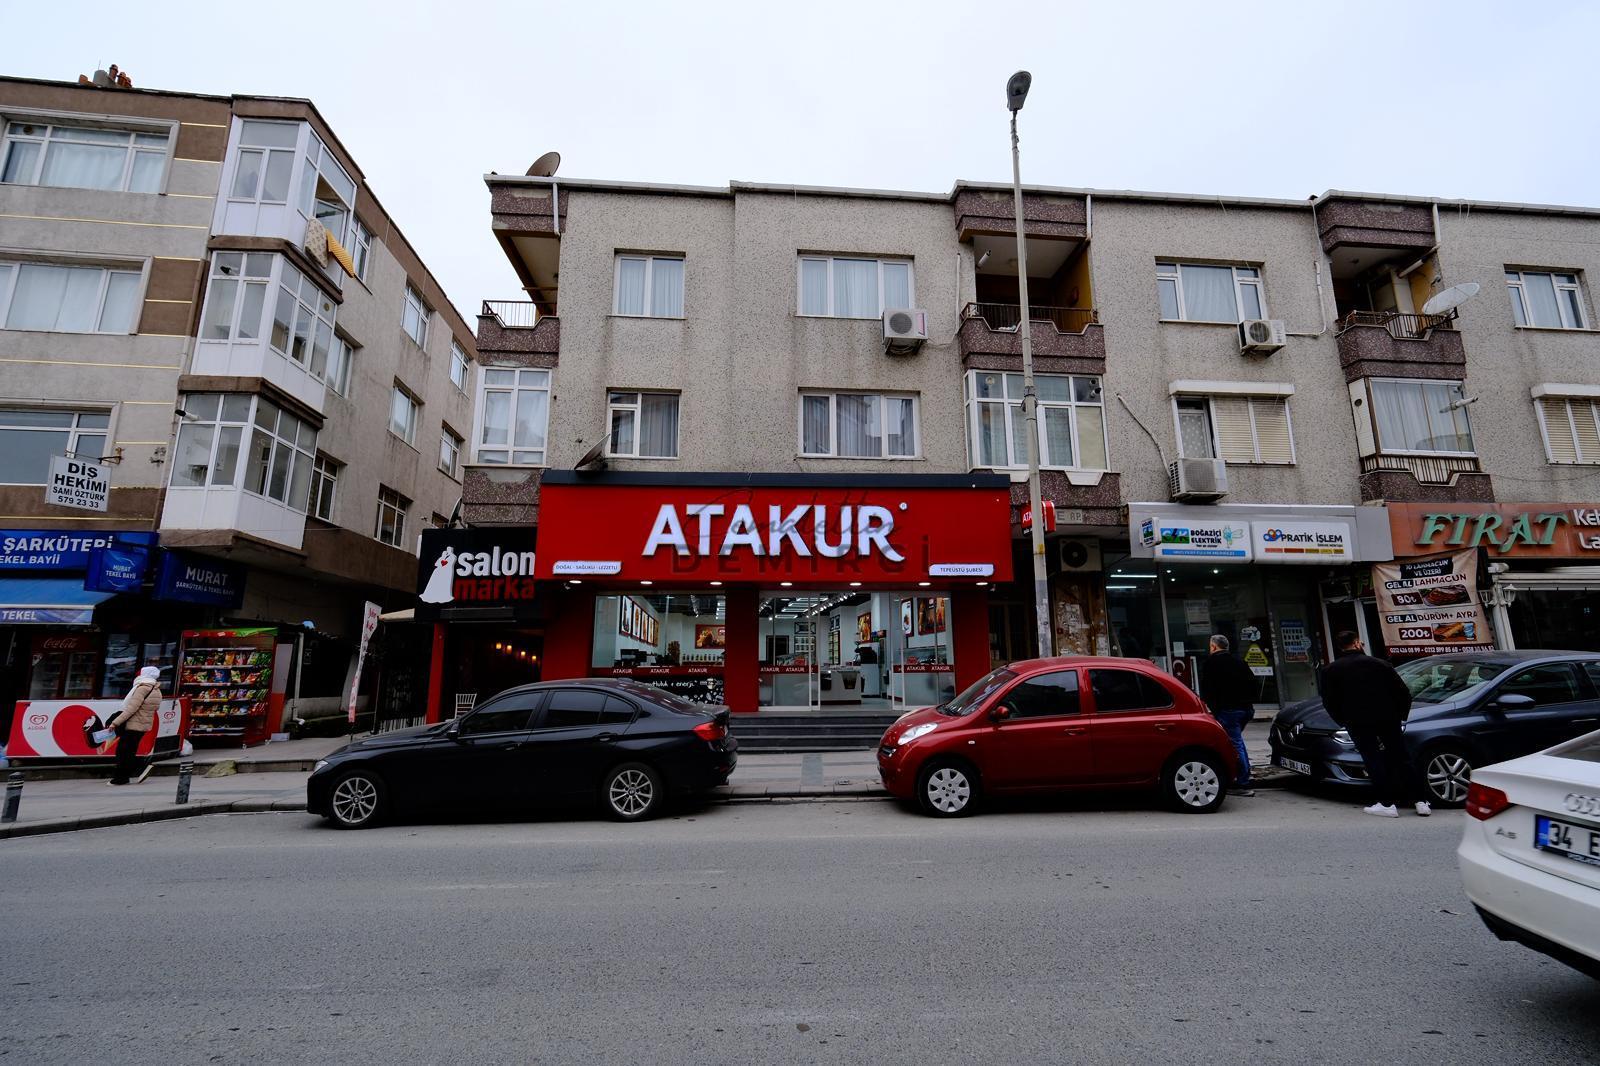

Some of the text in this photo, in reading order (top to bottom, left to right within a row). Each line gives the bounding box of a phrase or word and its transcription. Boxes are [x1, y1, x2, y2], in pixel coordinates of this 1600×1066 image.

[68, 463, 98, 479] DİŞ
[54, 473, 107, 493] HEKİMİ
[52, 486, 105, 501] SAMİ ÖZTÜRK
[57, 495, 74, 504] 579
[76, 499, 87, 507] 23
[642, 504, 905, 562] ATAKUR
[1190, 528, 1221, 537] BOĞAZİÇİ
[1191, 536, 1222, 544] ELEKTRİK
[1281, 532, 1343, 543] PRATİK İŞLEM
[1415, 512, 1569, 552] FIRAT
[456, 546, 536, 576] salon
[185, 566, 228, 586] MURAT
[1386, 581, 1402, 589] GEL
[1414, 573, 1467, 587] LAHMACUN
[454, 576, 535, 602] marka
[2, 610, 37, 620] TEKEL
[1387, 615, 1403, 623] GEL
[1549, 823, 1571, 849] 34
